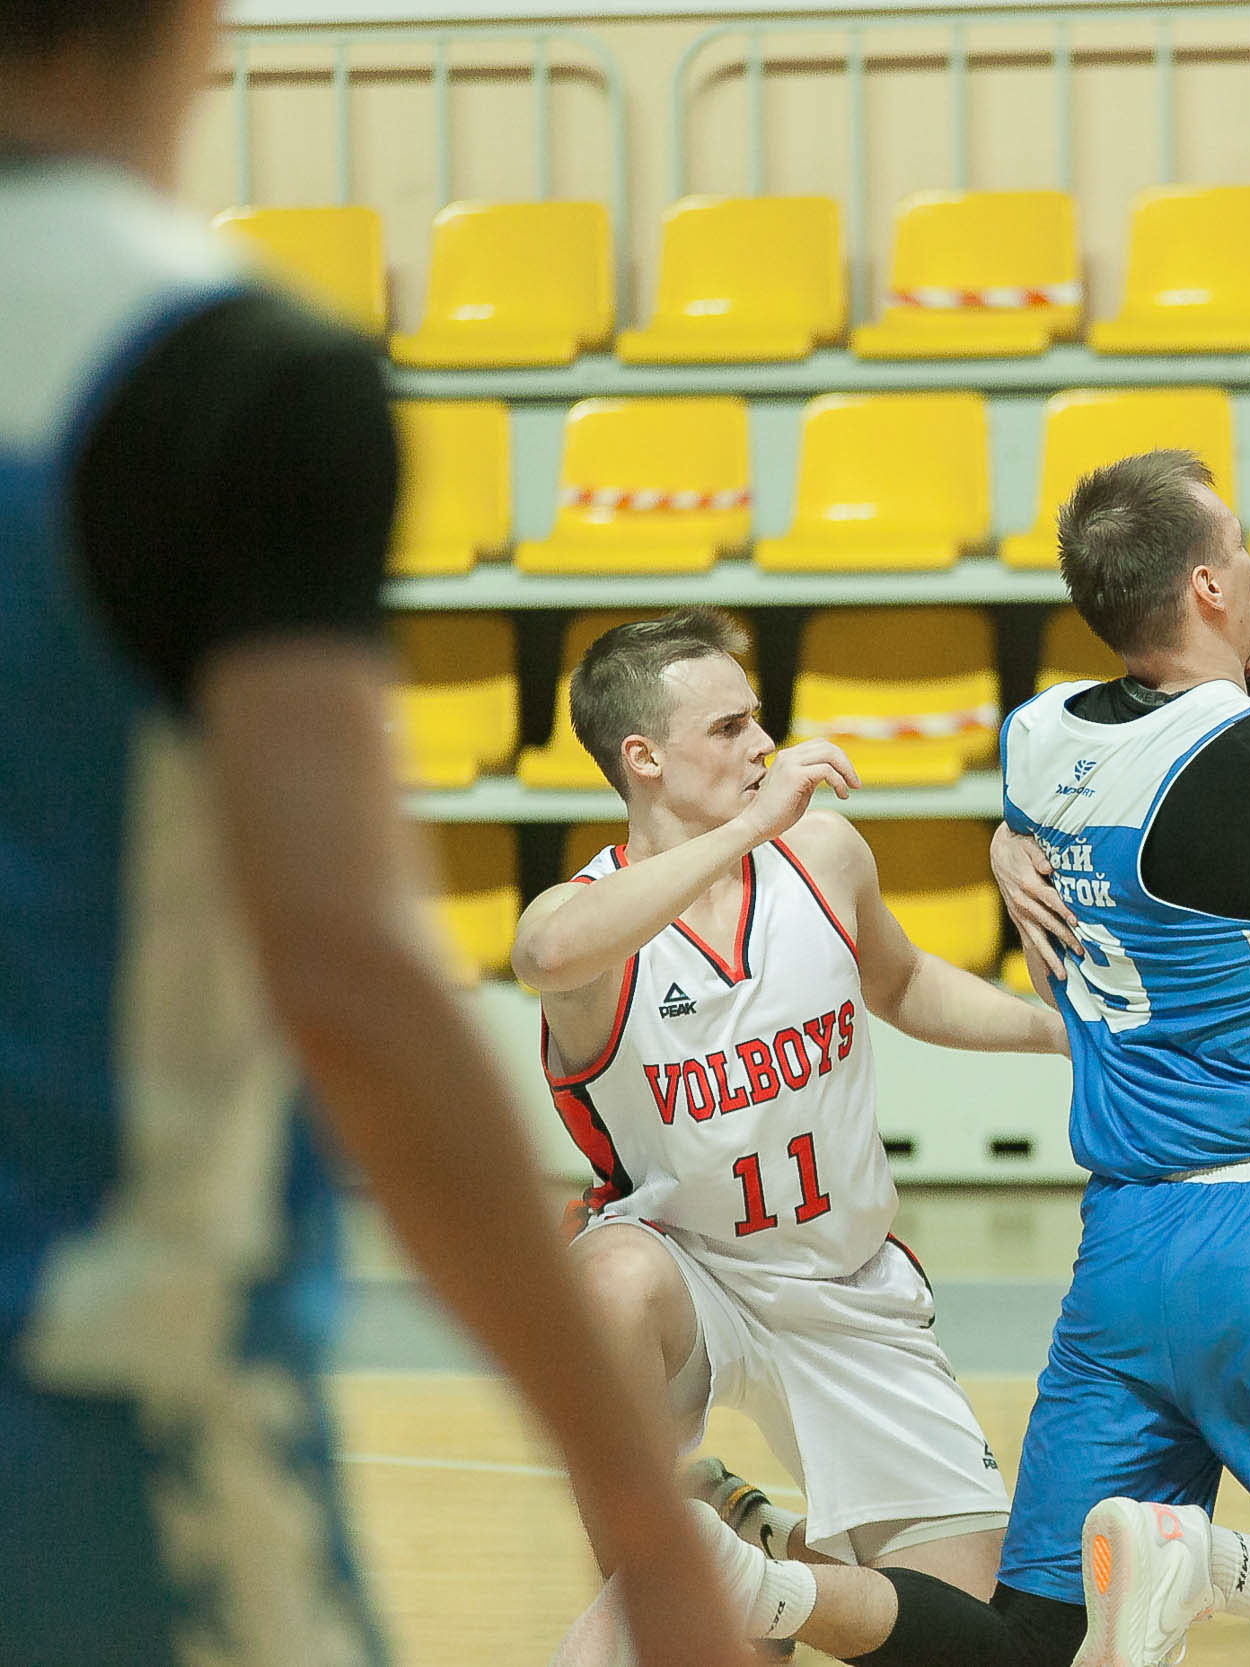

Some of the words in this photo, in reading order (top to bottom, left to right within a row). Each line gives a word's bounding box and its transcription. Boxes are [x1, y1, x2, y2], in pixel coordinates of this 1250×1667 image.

[643, 999, 855, 1125] VOLBOYS
[658, 1001, 697, 1019] PEAK
[732, 1131, 832, 1238] 11
